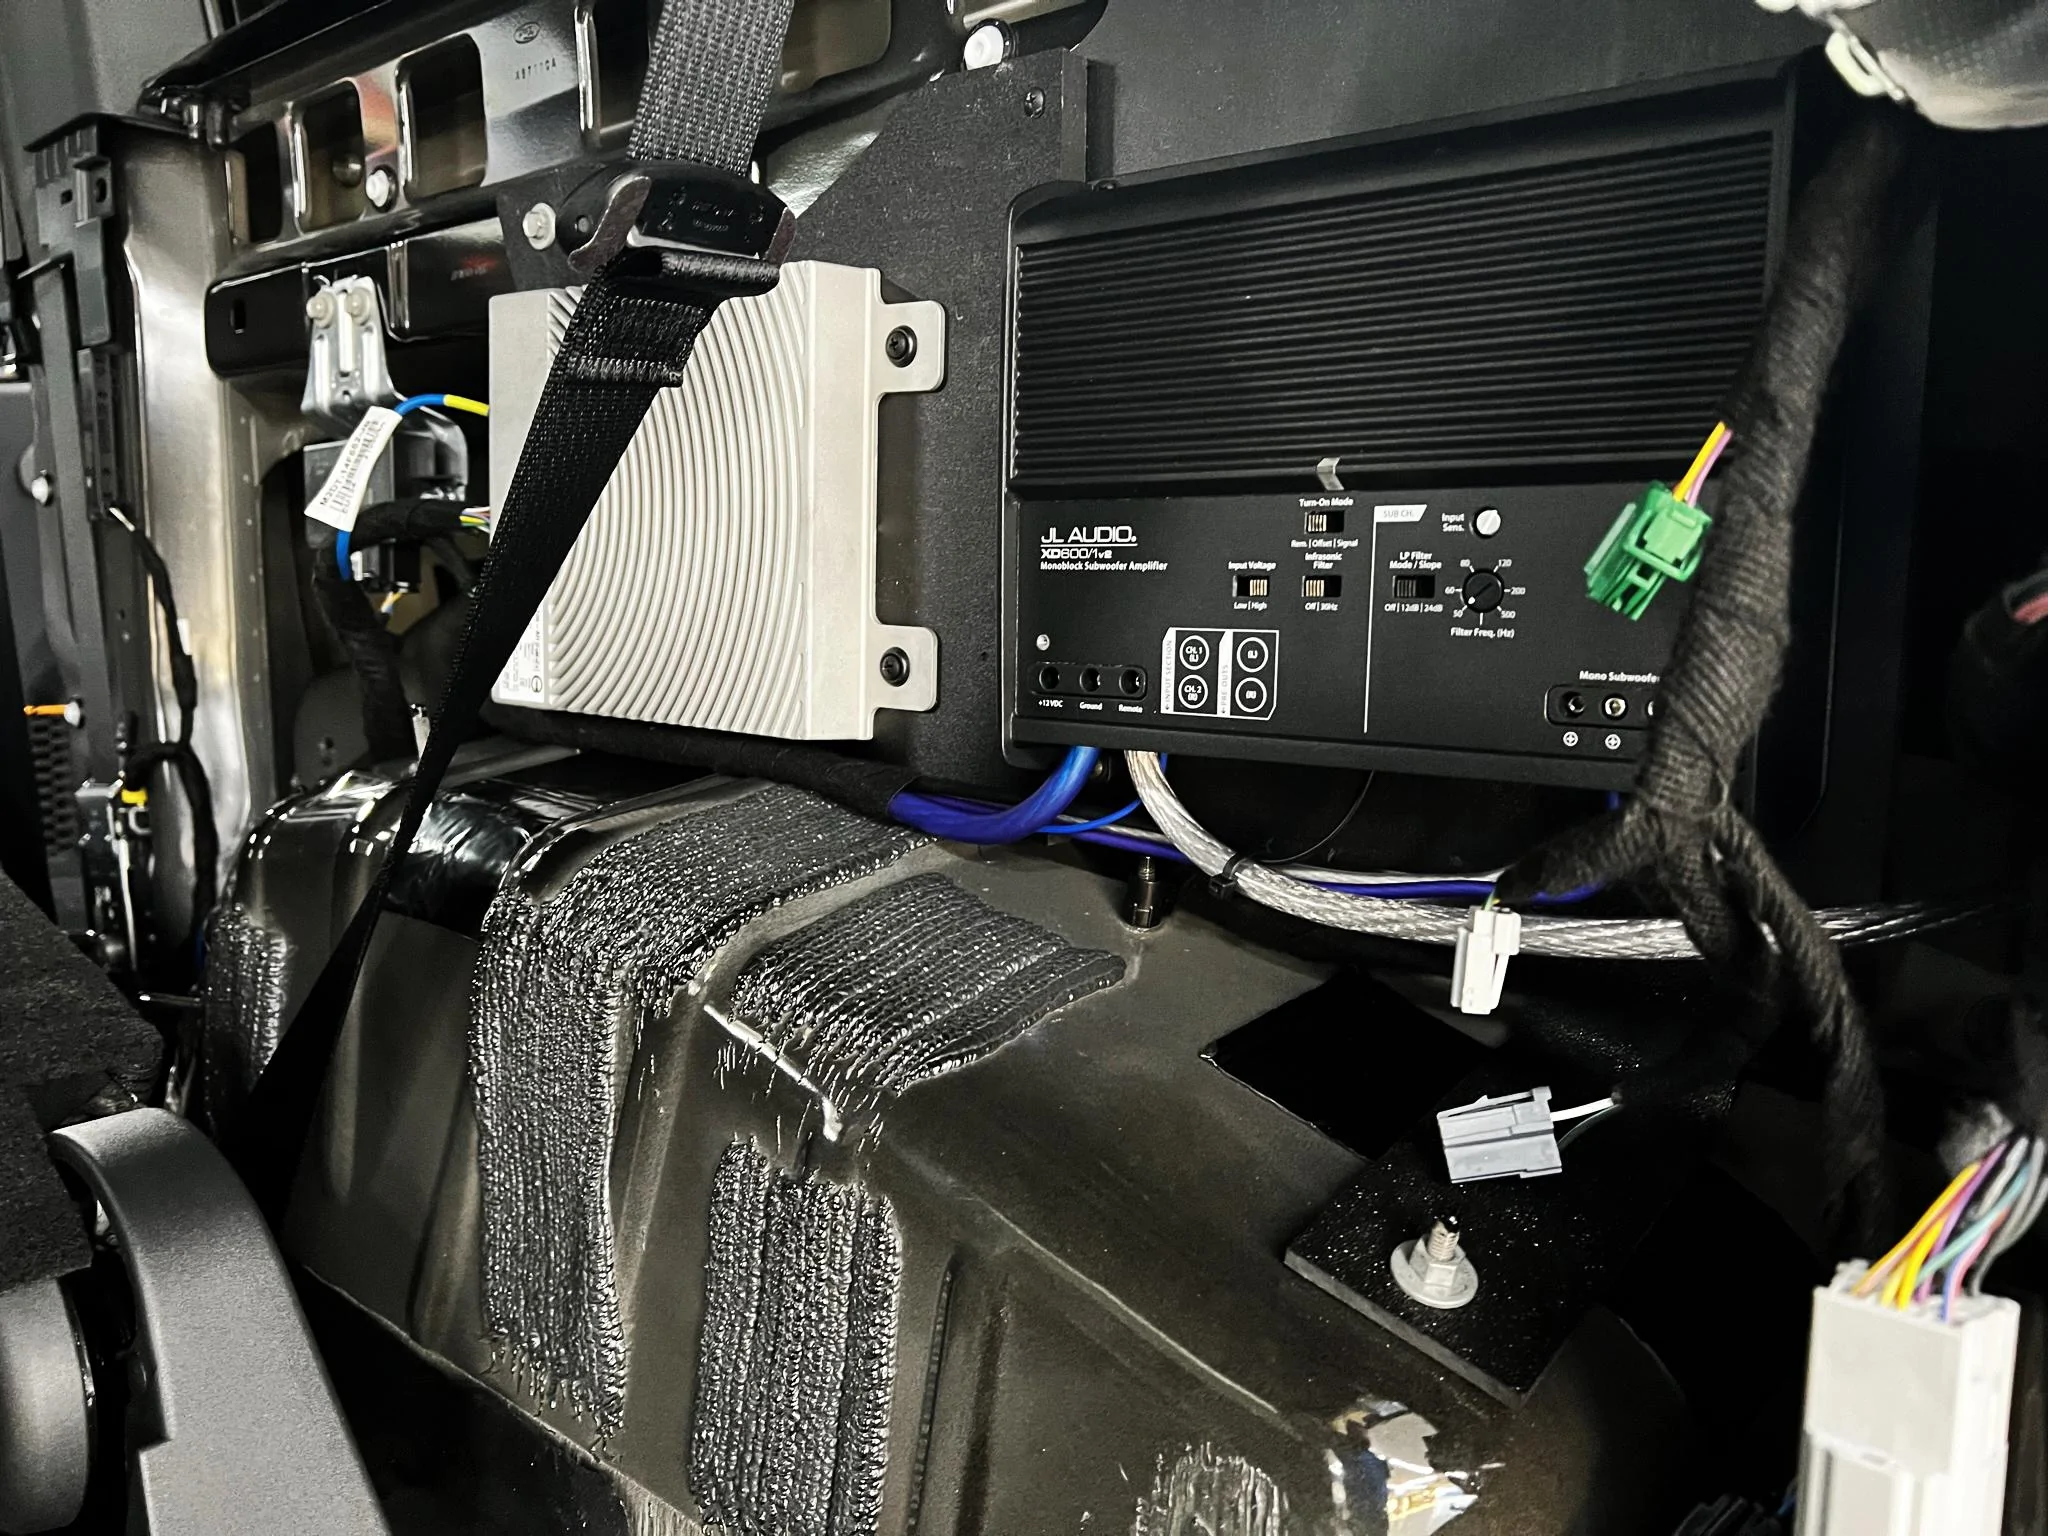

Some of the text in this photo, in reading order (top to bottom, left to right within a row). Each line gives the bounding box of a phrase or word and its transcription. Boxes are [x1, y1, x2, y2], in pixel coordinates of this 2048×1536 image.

[1299, 497, 1354, 507] Turn-On Mode
[1441, 513, 1465, 522] Input
[1442, 523, 1465, 532] Sens.
[1040, 527, 1065, 543] JL
[1311, 539, 1333, 548] Offset
[1337, 538, 1359, 549] Signal
[1305, 552, 1342, 561] Infrasonic
[1399, 551, 1433, 560] LP Filter
[1040, 560, 1168, 572] Monoblock Subwoofer Amplifier
[1228, 561, 1277, 572] Input Voltage
[1313, 561, 1334, 570] Filter
[1389, 560, 1412, 569] Mode
[1418, 560, 1442, 571] Slope
[1498, 558, 1513, 568] 120
[1444, 586, 1455, 595] 60
[1510, 586, 1526, 595] 200
[1233, 601, 1268, 612] Low High
[1304, 602, 1316, 611] Off
[1384, 603, 1396, 612] Off
[1452, 609, 1463, 619] 50
[1450, 627, 1515, 639] Filter Freq. (Hz)
[1165, 640, 1173, 676] SECTION
[1221, 664, 1229, 688] OUTS
[1579, 670, 1607, 681] Mono
[1079, 702, 1103, 710] Ground
[1118, 703, 1143, 713] Remote
